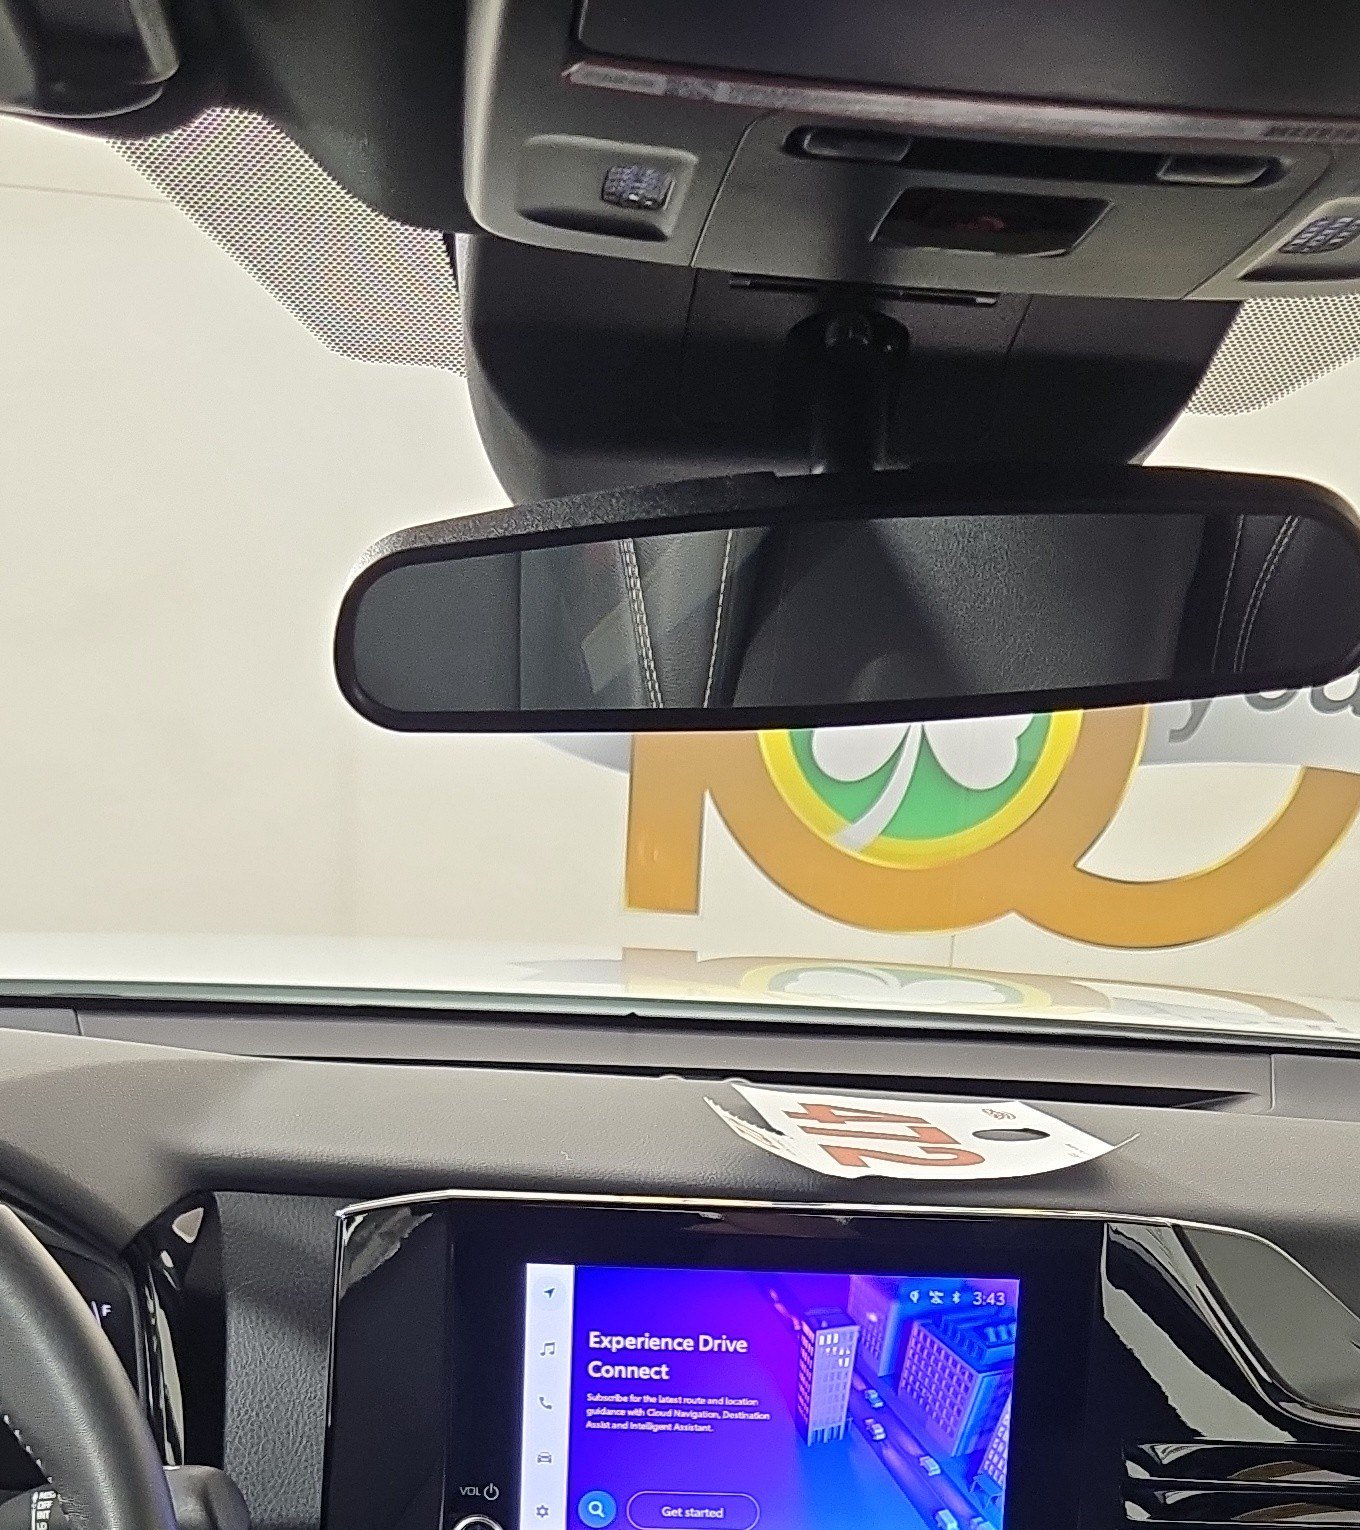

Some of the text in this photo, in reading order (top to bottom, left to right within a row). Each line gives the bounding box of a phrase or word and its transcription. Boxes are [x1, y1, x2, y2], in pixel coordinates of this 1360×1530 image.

[972, 1291, 1006, 1306] 3:43
[101, 1304, 112, 1316] F
[589, 1331, 748, 1353] Experience Drive
[587, 1360, 670, 1380] Connect
[586, 1393, 759, 1406] Subscribe for the latest route and location
[586, 1407, 770, 1420] guidance with Cloud Navigation, Destination
[585, 1420, 714, 1433] Assist and Intelligent Assistant.
[459, 1486, 481, 1496] VOL
[661, 1506, 724, 1518] Get started
